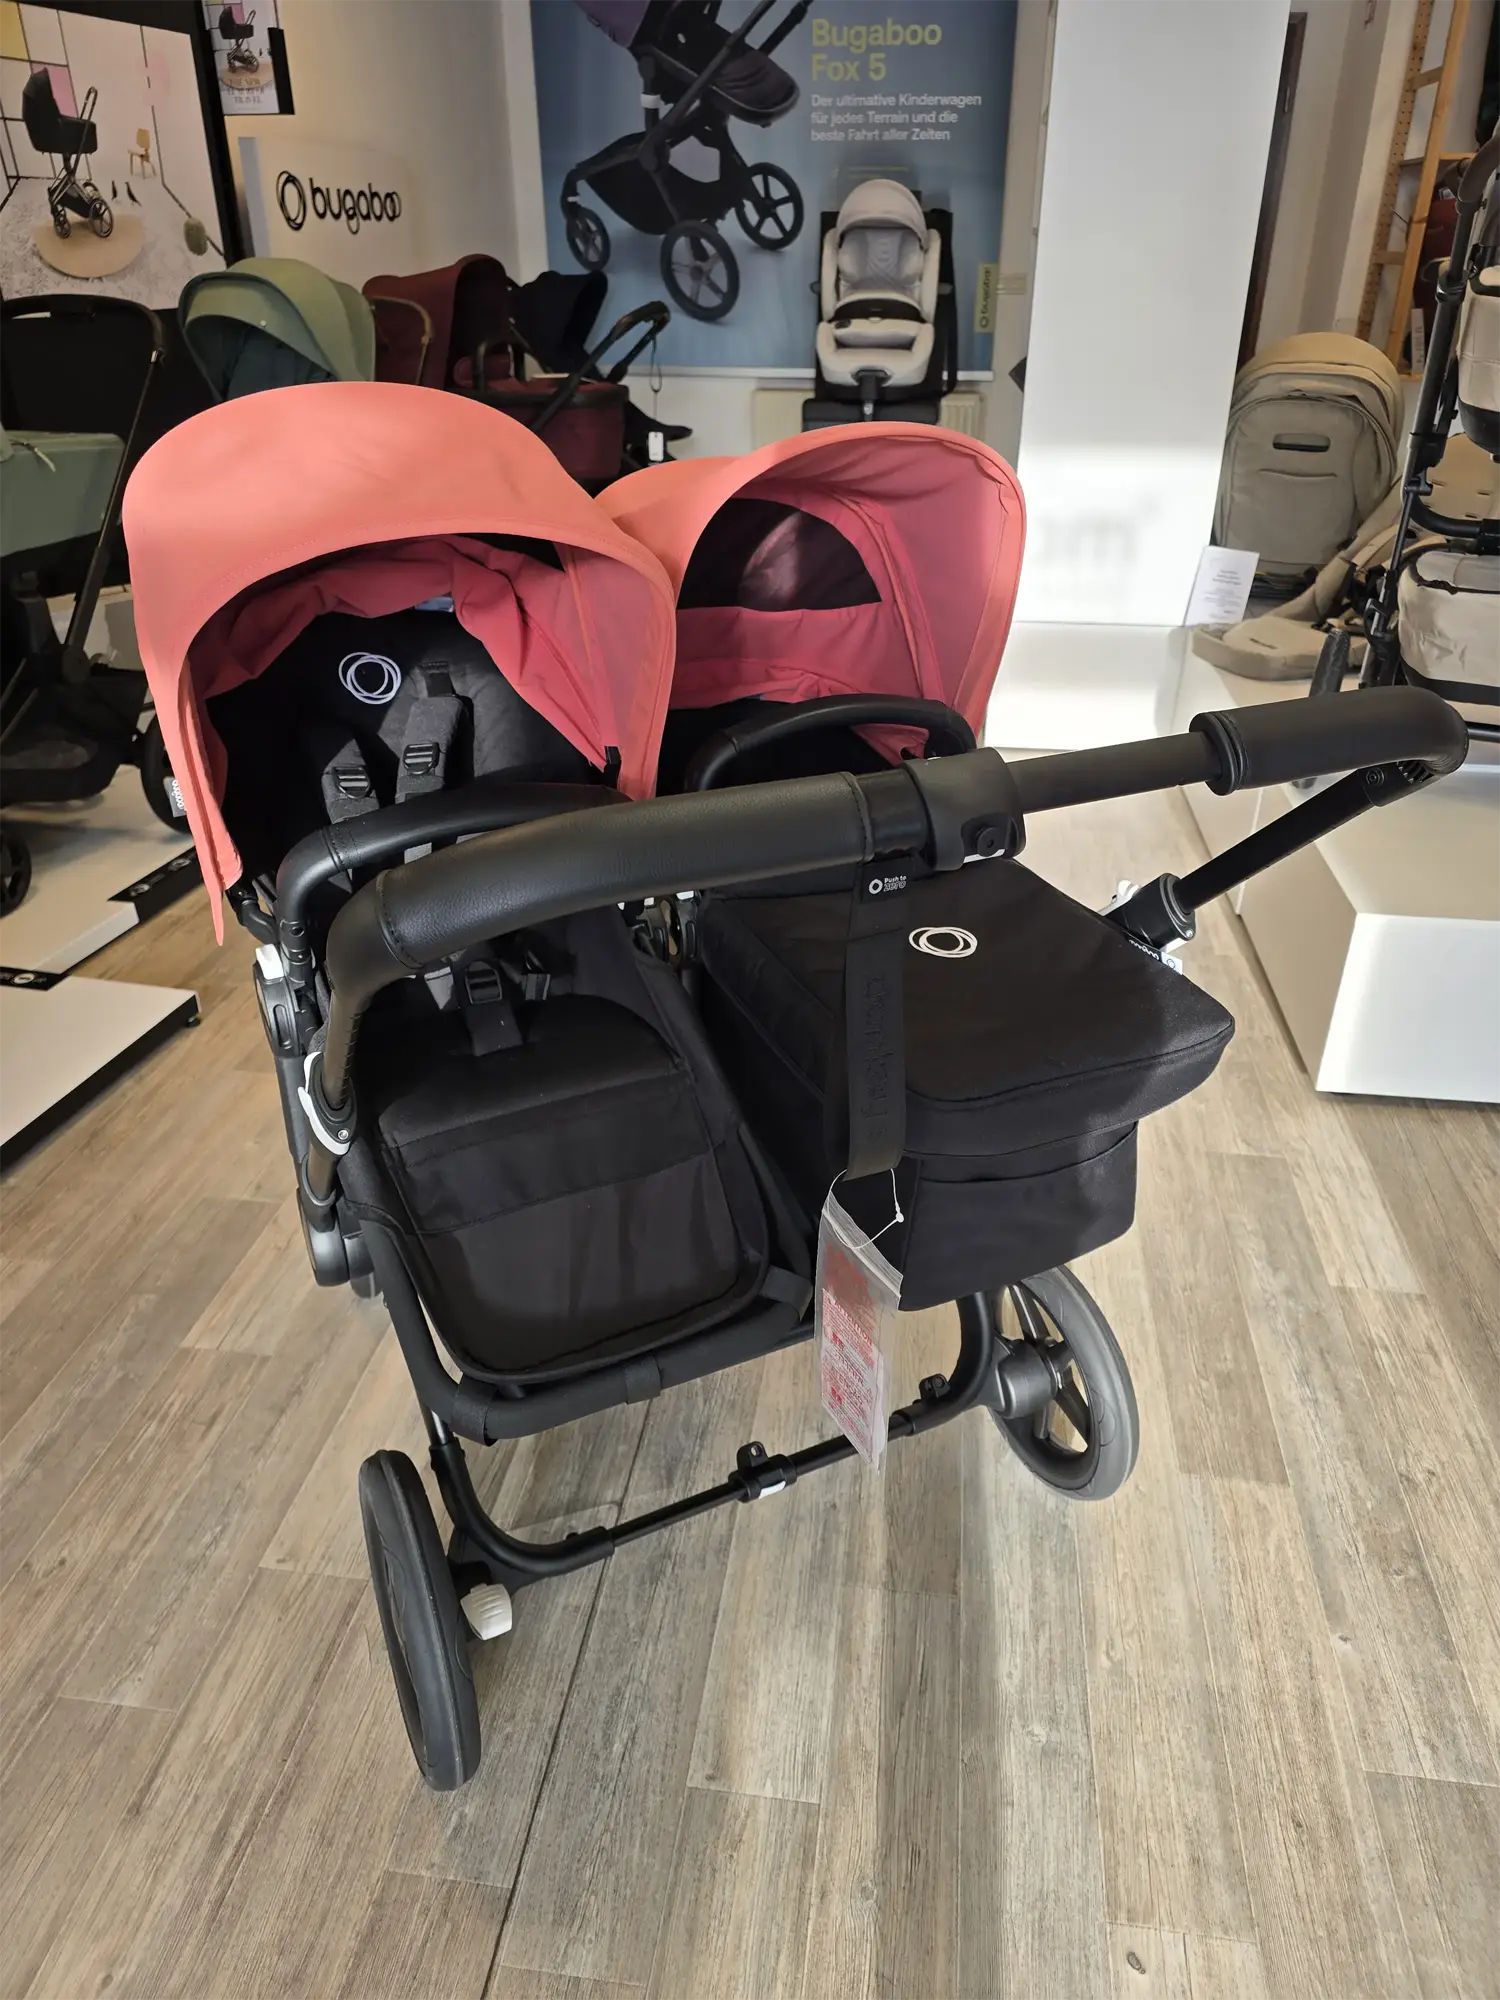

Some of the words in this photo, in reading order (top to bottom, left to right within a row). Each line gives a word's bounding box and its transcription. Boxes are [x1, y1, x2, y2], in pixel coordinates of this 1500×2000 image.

[812, 17, 942, 53] Bugaboo
[811, 53, 861, 82] Fox
[868, 52, 887, 81] 5
[810, 94, 834, 108] Der
[836, 93, 897, 107] ultimative
[899, 93, 983, 108] Kinderwagen
[811, 111, 830, 125] für
[830, 111, 866, 128] jedes
[866, 110, 910, 124] Terrain
[911, 110, 937, 124] und
[938, 110, 960, 124] die
[811, 129, 846, 142] beste
[847, 128, 880, 142] Fahrt
[882, 128, 909, 141] aller
[911, 127, 951, 141] Zeiten
[884, 876, 899, 884] Push
